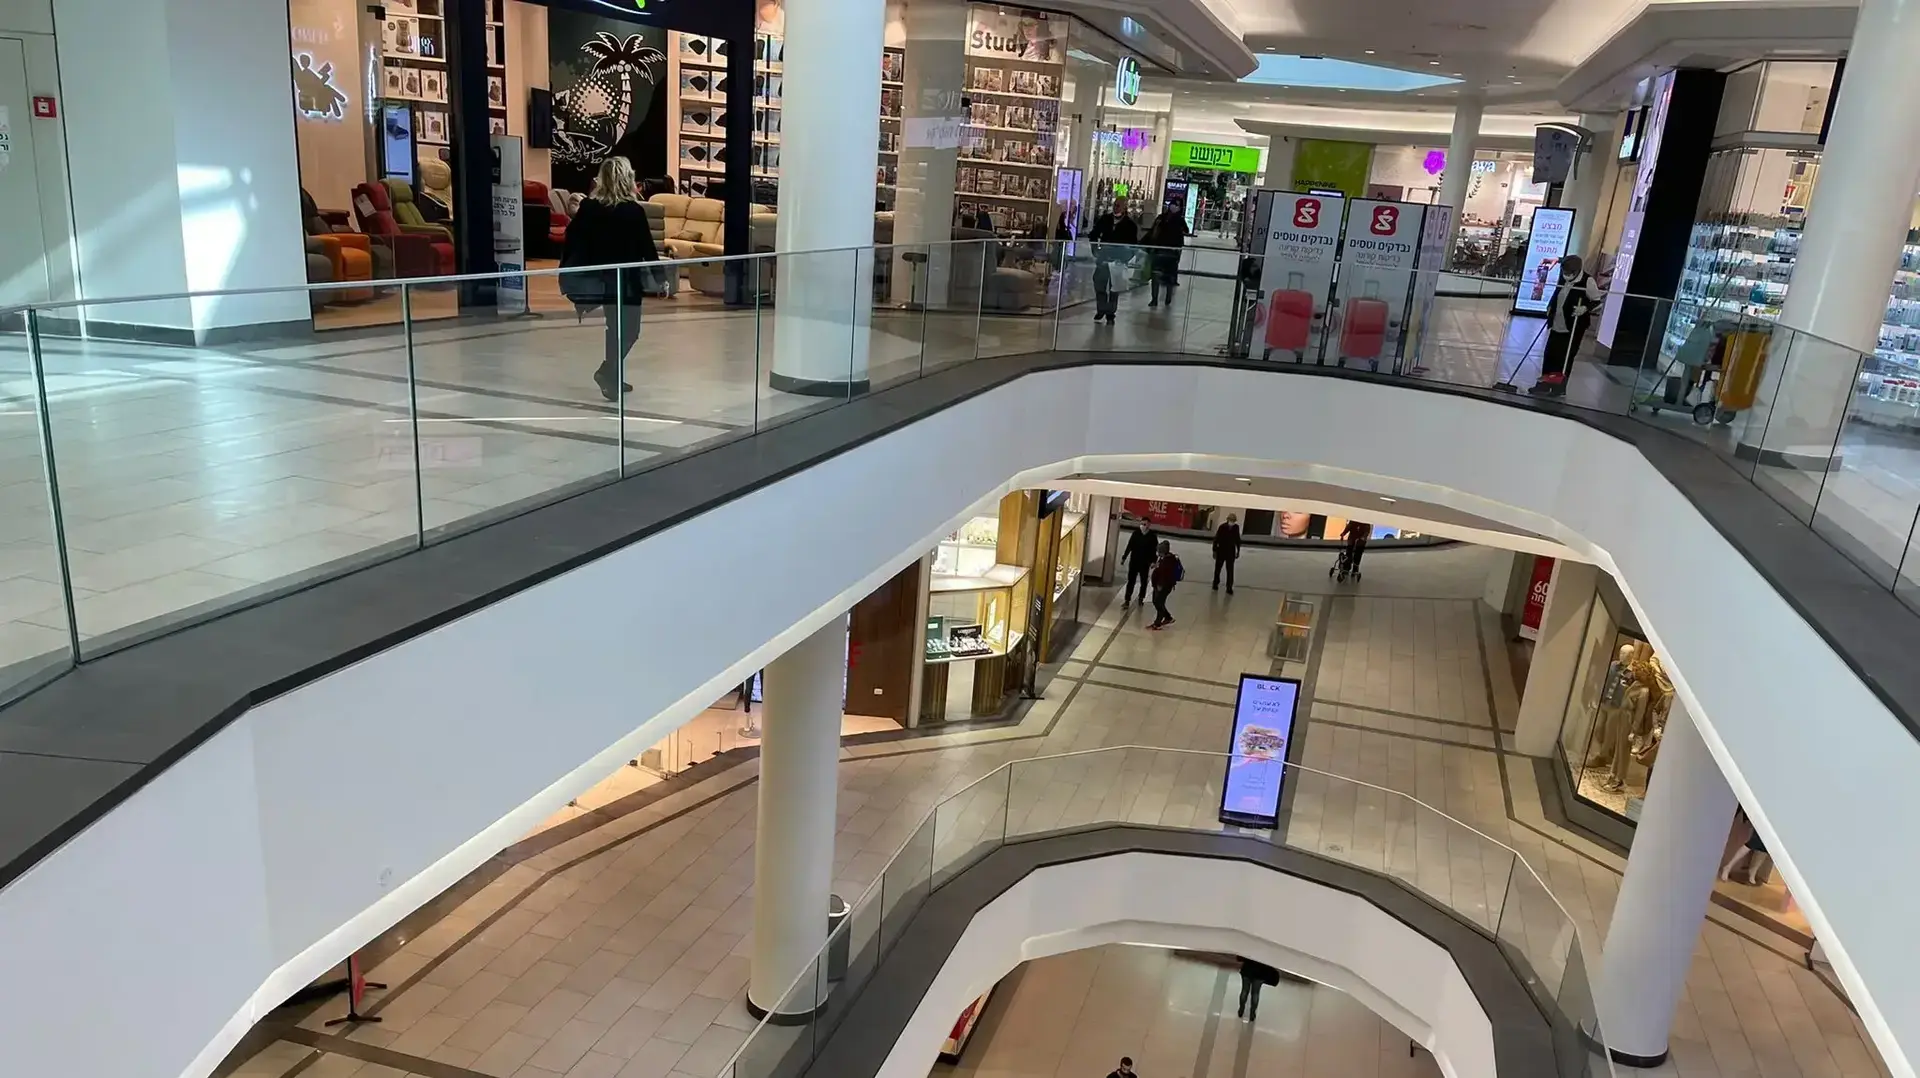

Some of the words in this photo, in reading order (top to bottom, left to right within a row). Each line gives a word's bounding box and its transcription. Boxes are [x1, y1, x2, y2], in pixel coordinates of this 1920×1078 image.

[971, 30, 1028, 57] Study
[1189, 146, 1232, 165] ריקושט
[1294, 180, 1337, 189] HAPPENING
[1273, 231, 1299, 242] וטסים
[1301, 234, 1334, 246] נבדקים
[1350, 239, 1376, 249] וטסים
[1378, 242, 1411, 253] נבדקים
[1148, 500, 1168, 514] SALE
